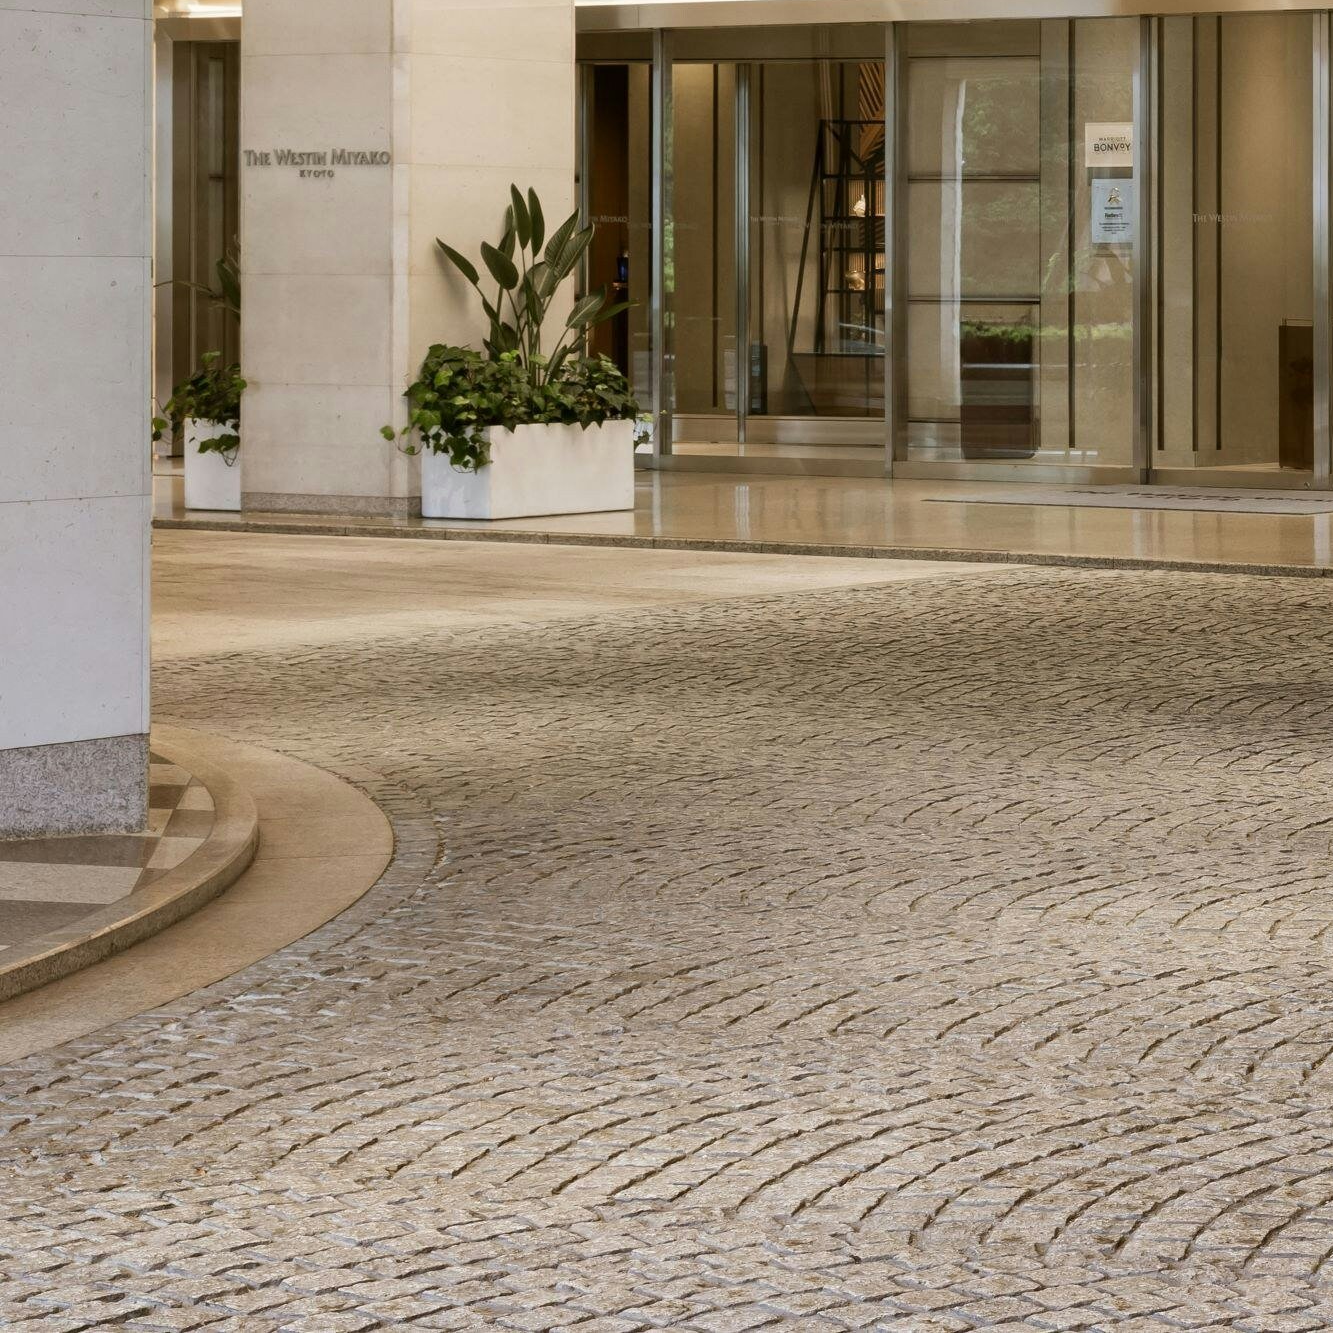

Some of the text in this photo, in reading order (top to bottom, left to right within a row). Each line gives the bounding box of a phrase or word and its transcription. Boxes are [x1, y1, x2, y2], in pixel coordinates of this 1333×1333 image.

[243, 148, 392, 166] THE WESTIN MIYAKO
[299, 169, 335, 178] KYOTO
